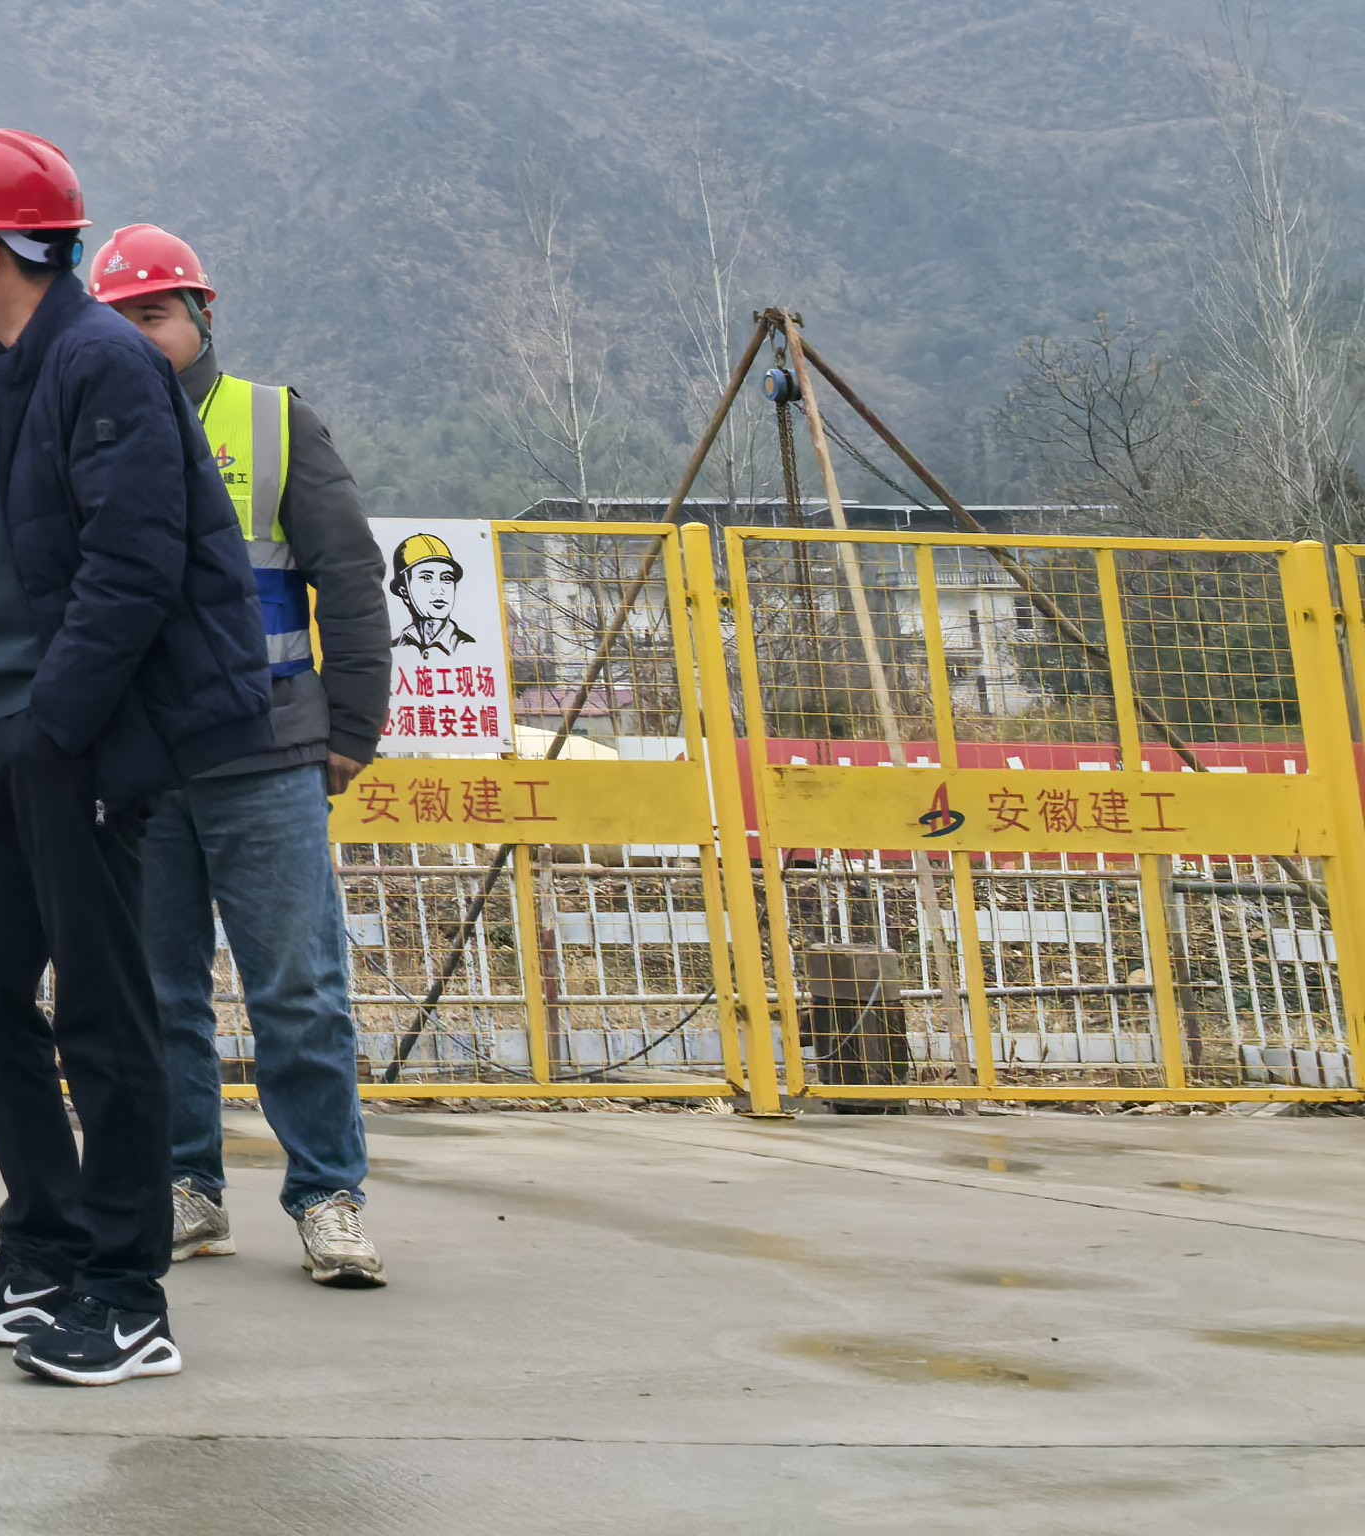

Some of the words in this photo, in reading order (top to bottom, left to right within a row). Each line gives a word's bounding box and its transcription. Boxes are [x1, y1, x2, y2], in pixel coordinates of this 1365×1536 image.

[390, 665, 495, 697] 入施工现场
[380, 704, 499, 737] 必须戴安全帽
[357, 776, 558, 824] 安徽建工
[987, 786, 1181, 834] 安徽建工
